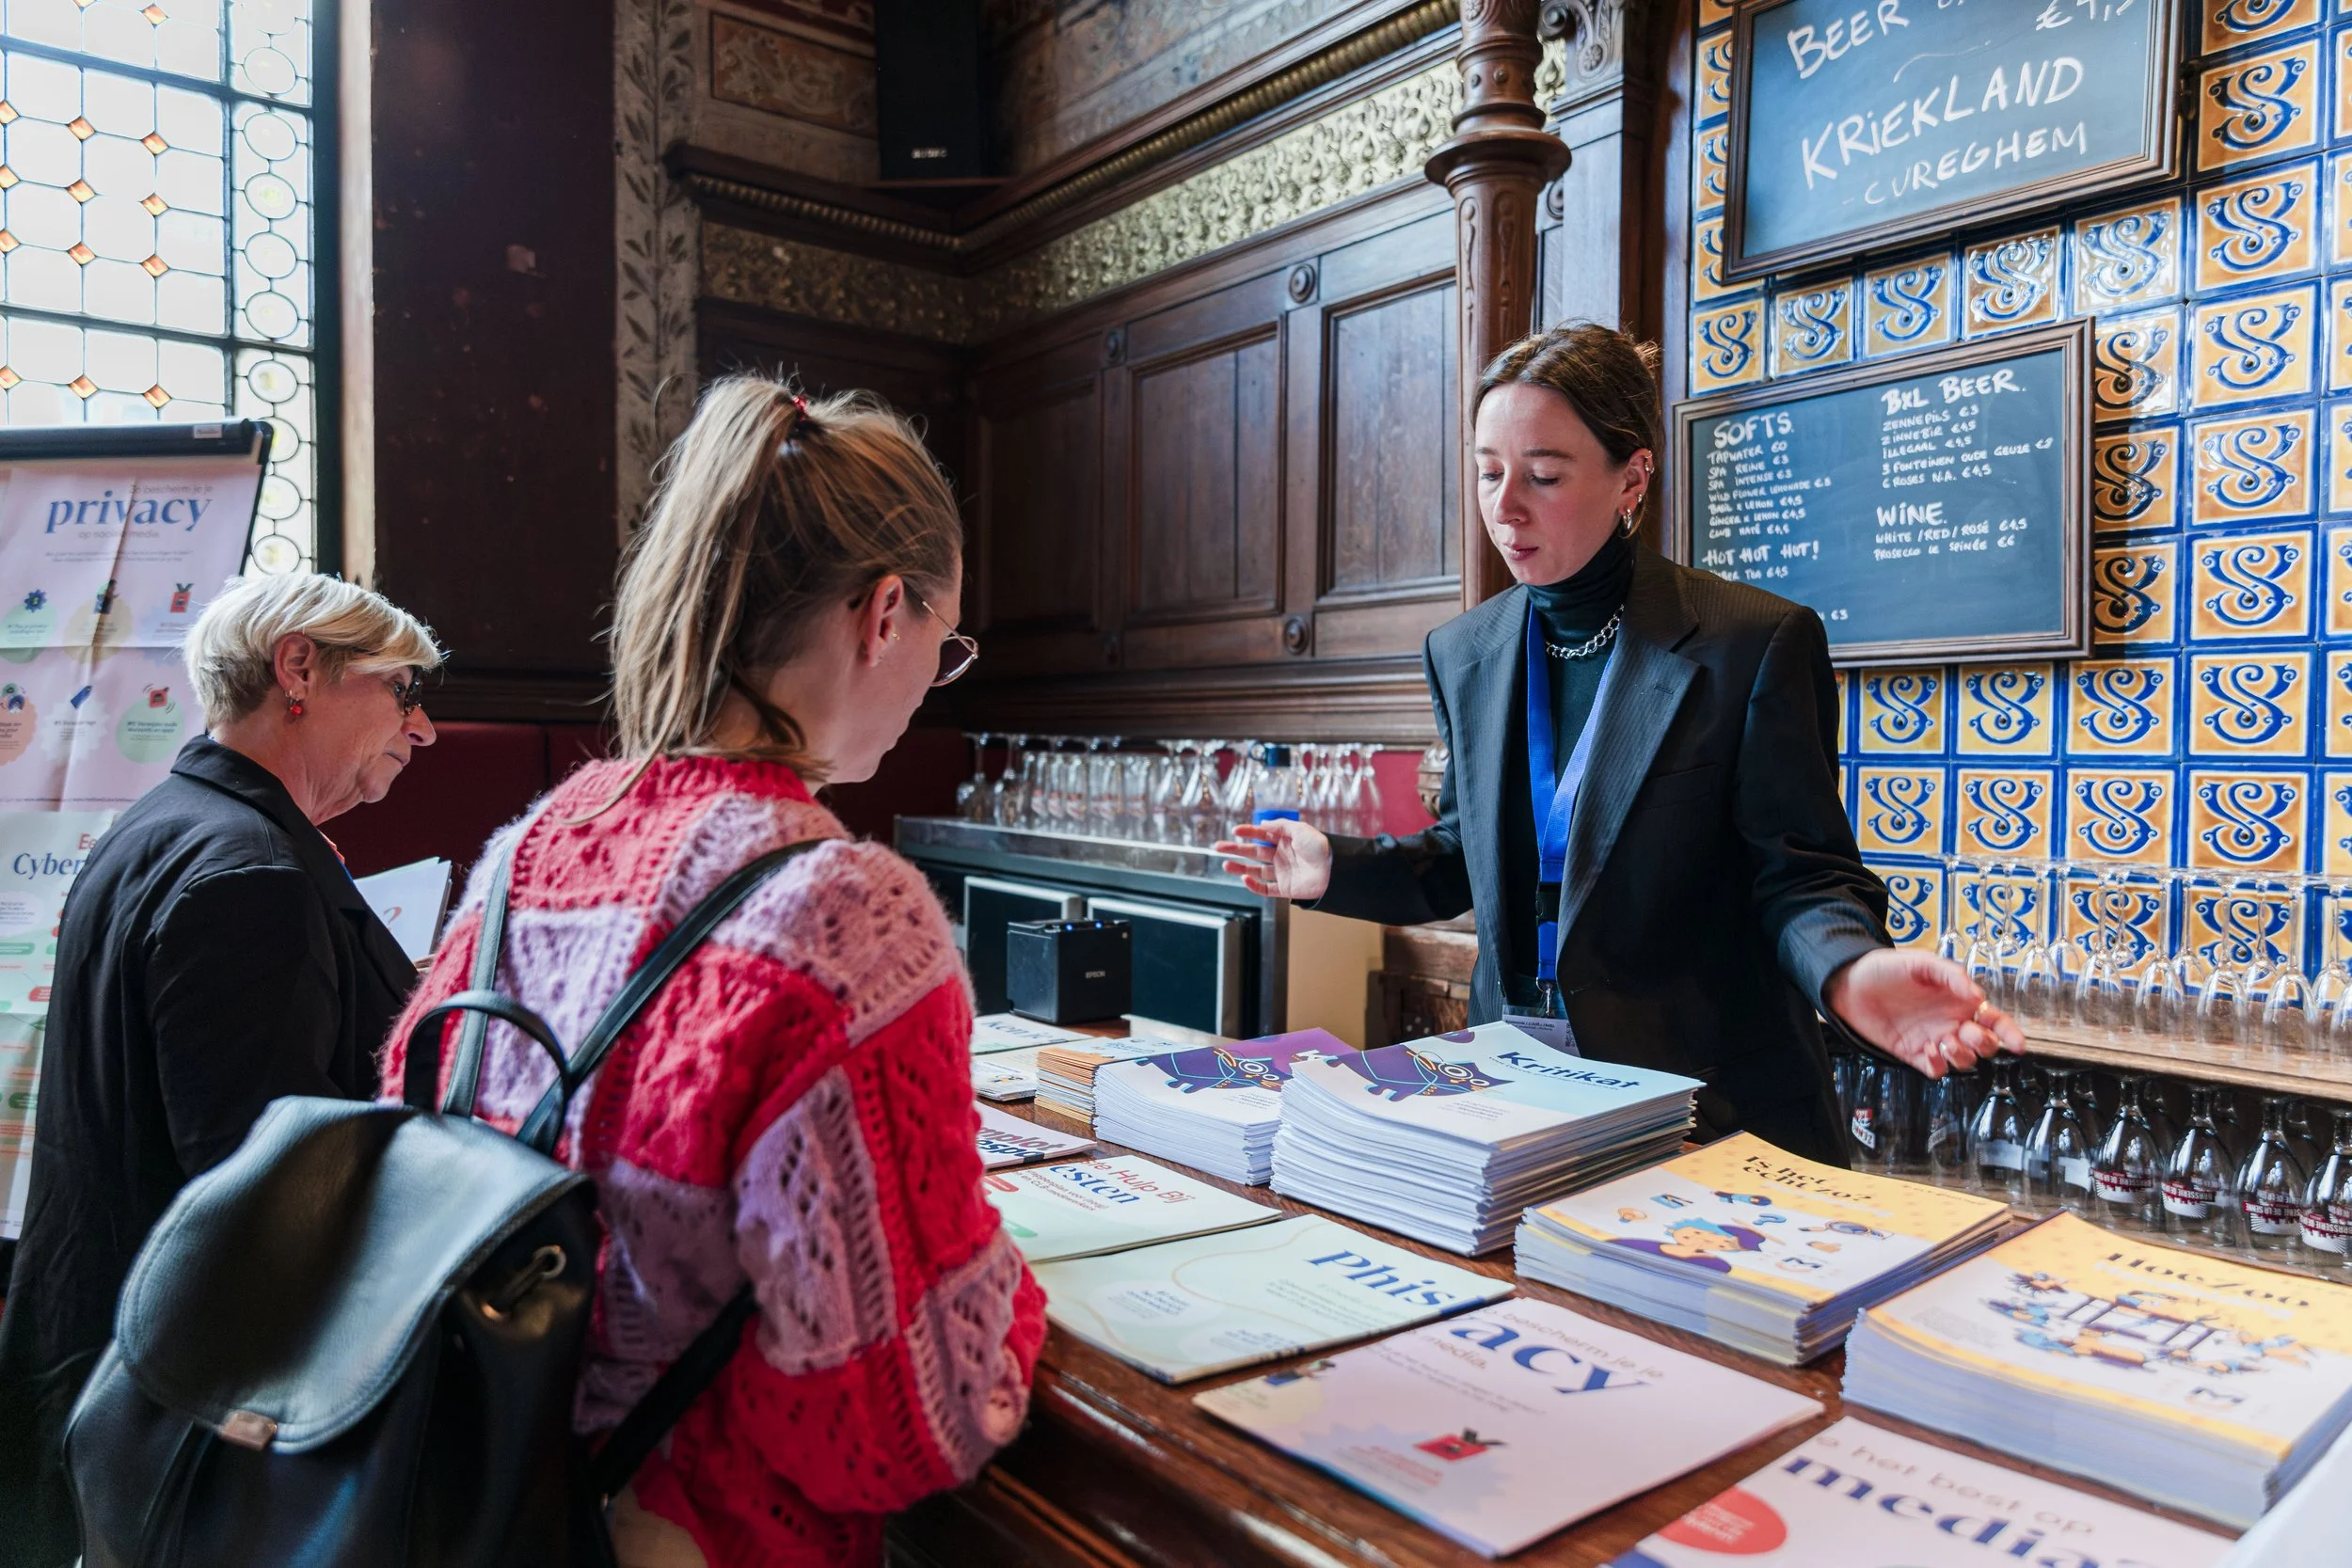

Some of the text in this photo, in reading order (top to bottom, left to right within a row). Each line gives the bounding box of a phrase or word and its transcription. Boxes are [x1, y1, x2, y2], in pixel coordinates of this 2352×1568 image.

[1788, 0, 1909, 79] BEER
[1865, 120, 2087, 205] CUREGHEM
[1881, 387, 1929, 416] BXL
[1707, 444, 1764, 465] TAPWATER
[1961, 450, 1988, 463] OUDE
[1994, 443, 2030, 456] GEUZE
[1708, 467, 1727, 480] SPA
[1708, 480, 1724, 491] SPA
[1770, 480, 1810, 494] LEMONADE
[1893, 473, 1926, 487] ROSES
[44, 490, 213, 534] privacy
[1497, 1052, 1641, 1088] Kritikat
[978, 1127, 1067, 1150] mplot
[1108, 1169, 1158, 1192] Hulp
[1156, 1190, 1196, 1204] Bij
[1502, 1313, 1609, 1359] bescherm
[1450, 1316, 1652, 1394] acy
[1783, 1454, 2156, 1568] media
